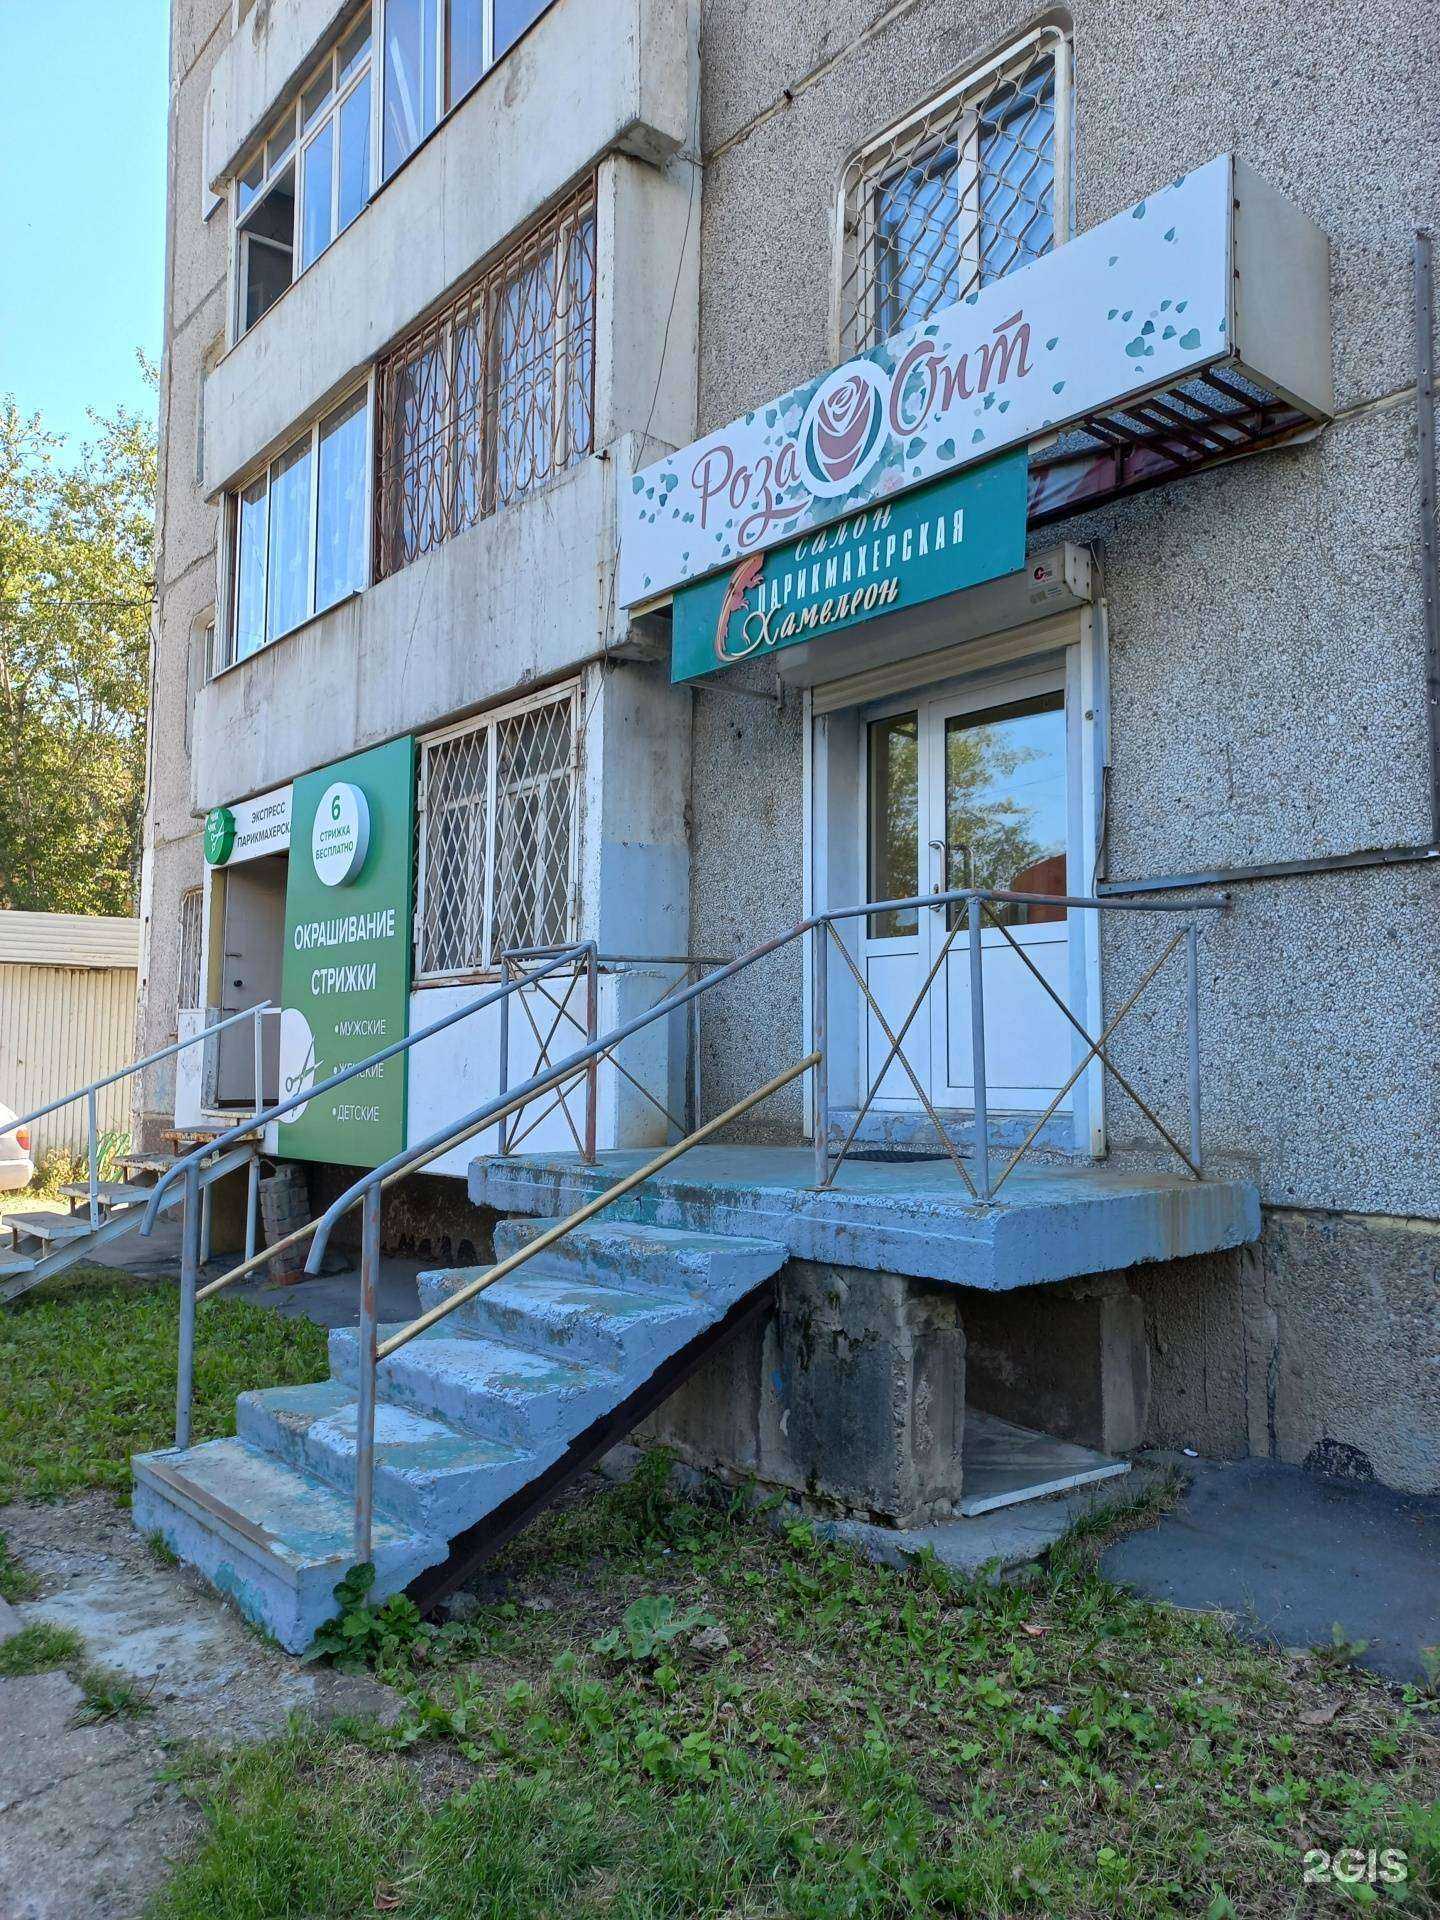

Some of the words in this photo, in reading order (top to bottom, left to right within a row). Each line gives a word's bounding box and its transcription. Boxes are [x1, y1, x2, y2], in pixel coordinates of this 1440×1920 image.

[692, 445, 810, 547] Роза
[757, 508, 965, 613] ПАРИКМАХЕРСКАЯ
[251, 801, 286, 824] ЭКСПРЕСС
[331, 794, 341, 821] 6
[237, 821, 291, 848] ПАРИКМАХЕРСК
[320, 824, 351, 842] СТРИЖКА
[315, 841, 354, 860] БЕСПЛАТНО
[294, 908, 395, 951] ОКРАШИВАНИЕ
[311, 962, 377, 996] СТРИЖКИ
[339, 1019, 386, 1036] МУЖСКИЕ
[338, 1062, 384, 1078] ЖСКИЕ
[337, 1104, 380, 1122] ДЕТСКИЕ
